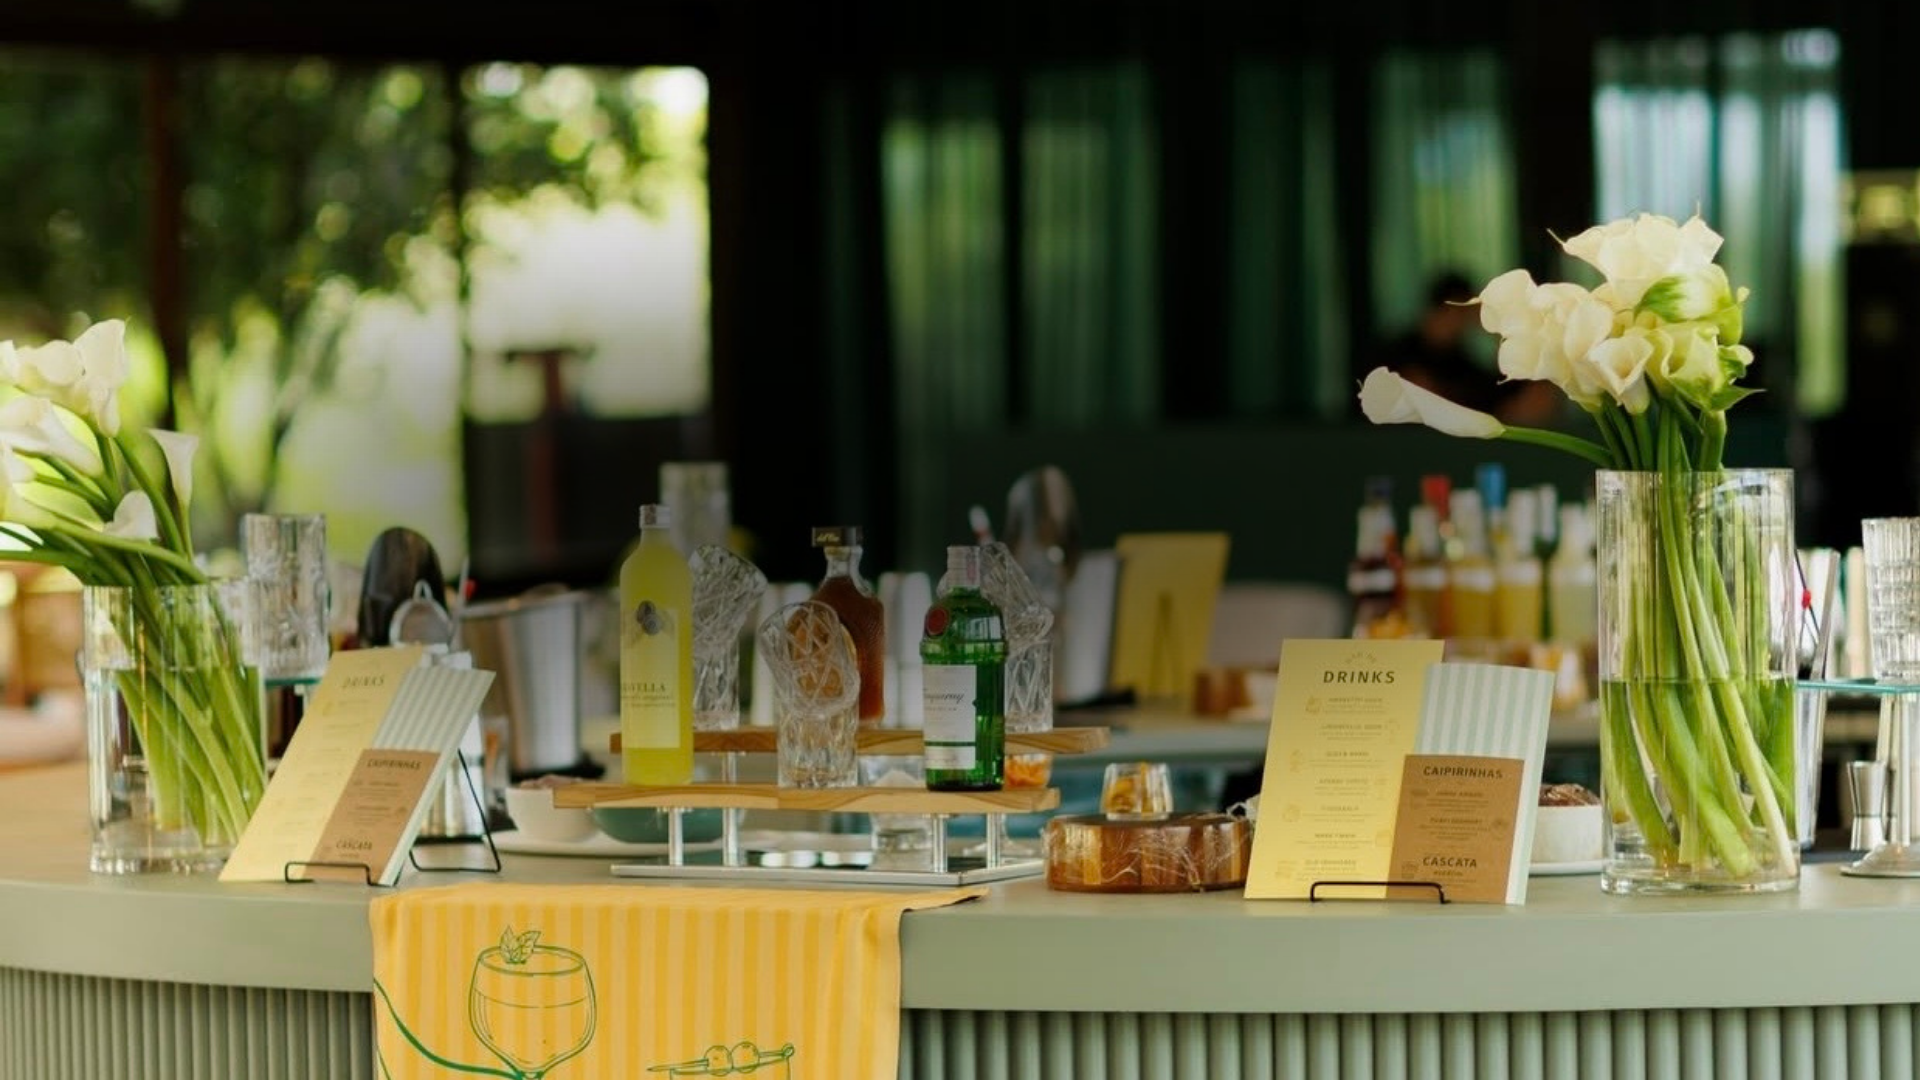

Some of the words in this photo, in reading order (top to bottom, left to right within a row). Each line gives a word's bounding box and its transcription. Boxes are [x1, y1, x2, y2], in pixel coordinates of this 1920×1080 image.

[1323, 670, 1395, 684] DRINKS
[1422, 765, 1503, 779] CAIPIRINHAS
[1422, 856, 1477, 869] CASCATA
